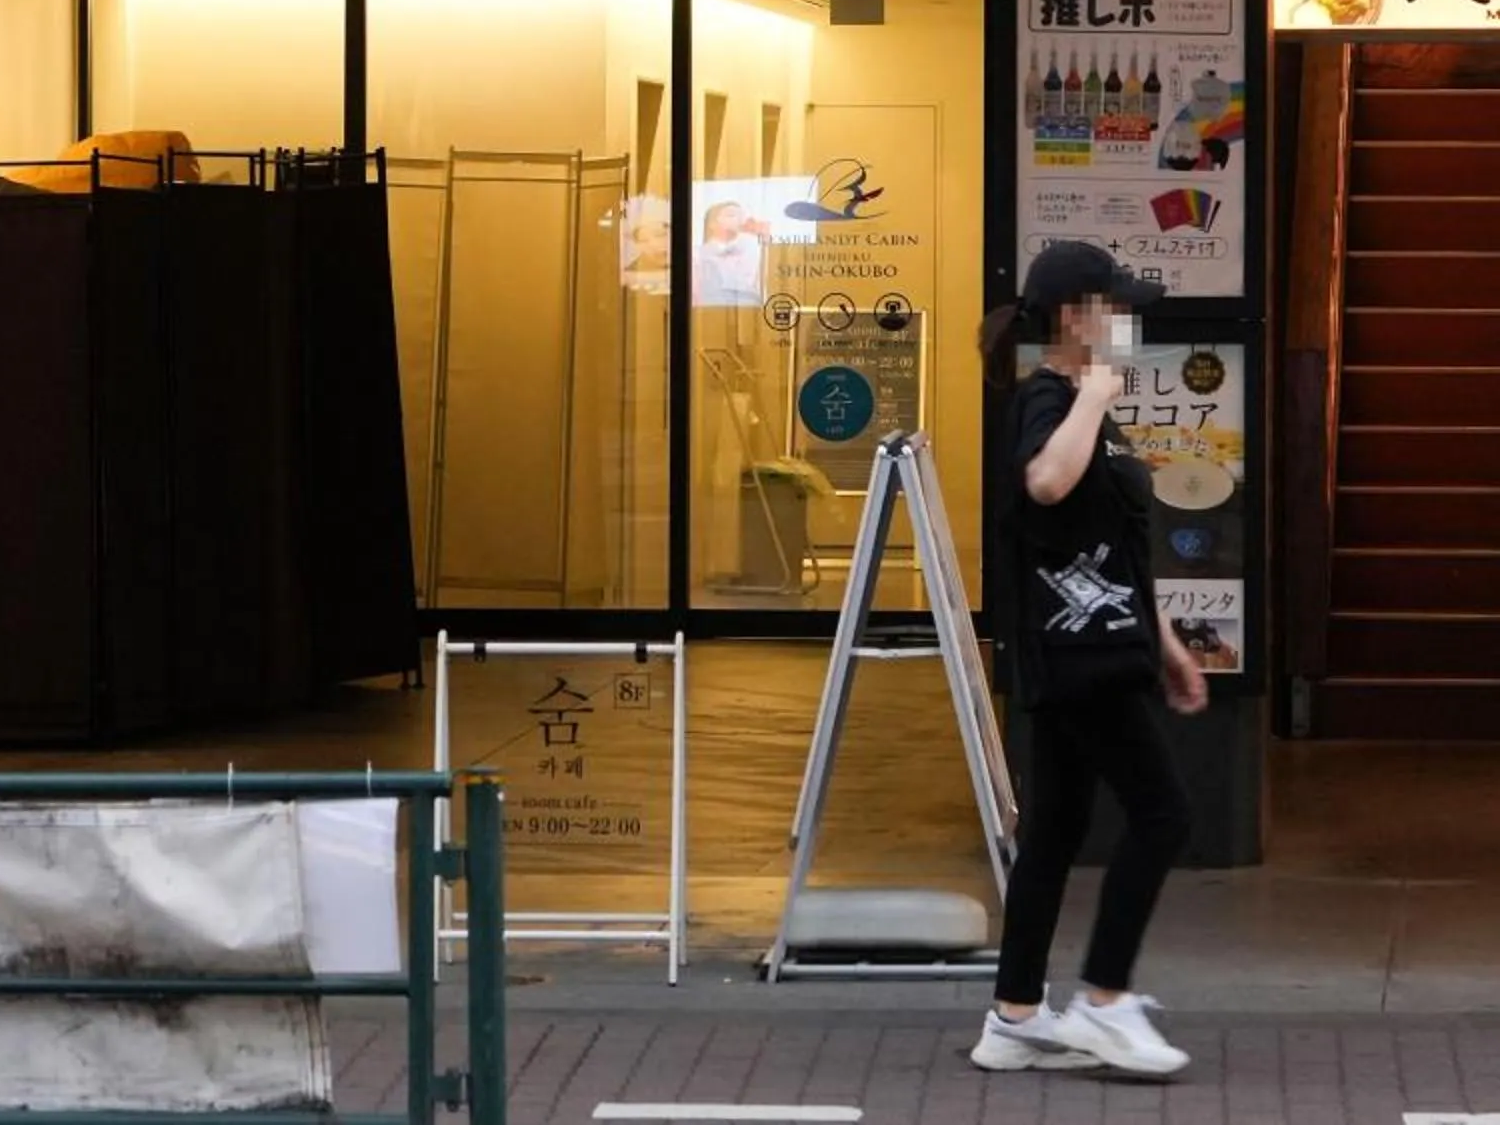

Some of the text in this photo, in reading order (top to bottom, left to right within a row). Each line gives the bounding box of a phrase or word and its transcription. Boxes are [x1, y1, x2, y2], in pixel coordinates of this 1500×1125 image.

[865, 231, 920, 247] CABIN
[1113, 402, 1219, 431] ココア
[618, 680, 645, 701] 8F
[527, 675, 594, 748] 숨
